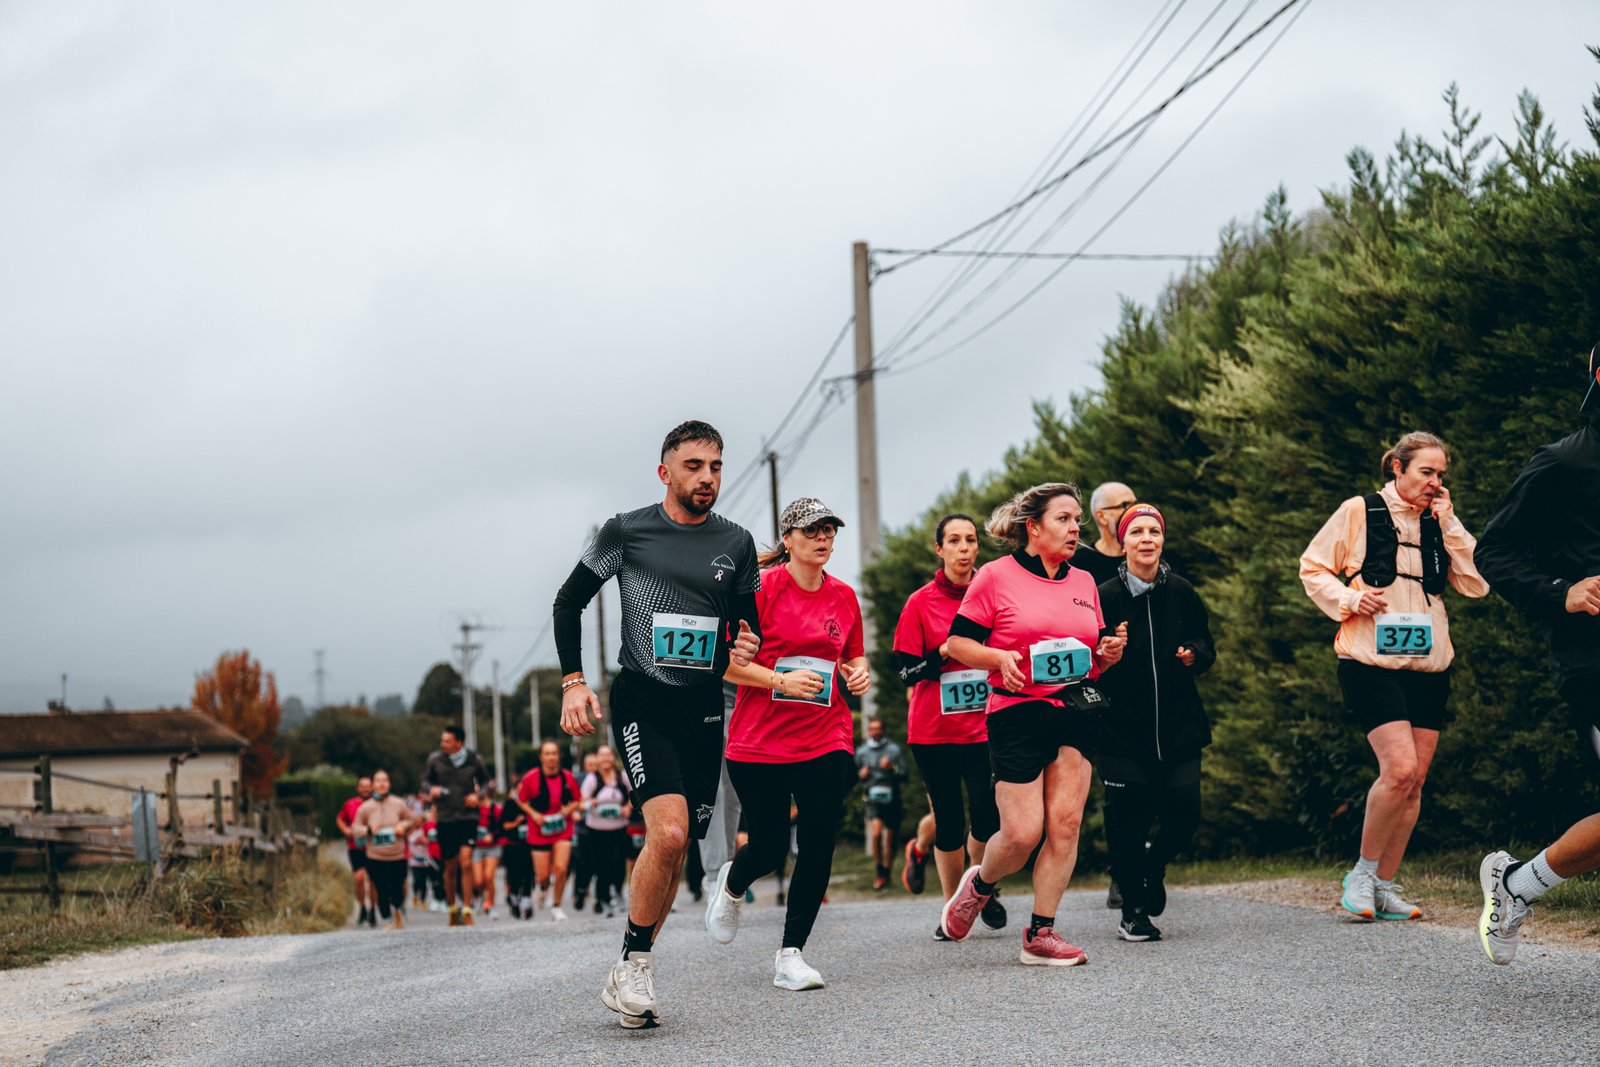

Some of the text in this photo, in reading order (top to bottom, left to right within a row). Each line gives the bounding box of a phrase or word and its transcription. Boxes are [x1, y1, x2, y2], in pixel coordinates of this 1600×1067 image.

[662, 631, 708, 657] 121
[1383, 627, 1427, 647] 373
[1046, 653, 1075, 677] 81
[948, 681, 989, 705] 199
[623, 721, 646, 789] SHARKS
[1485, 867, 1502, 938] HYROX
